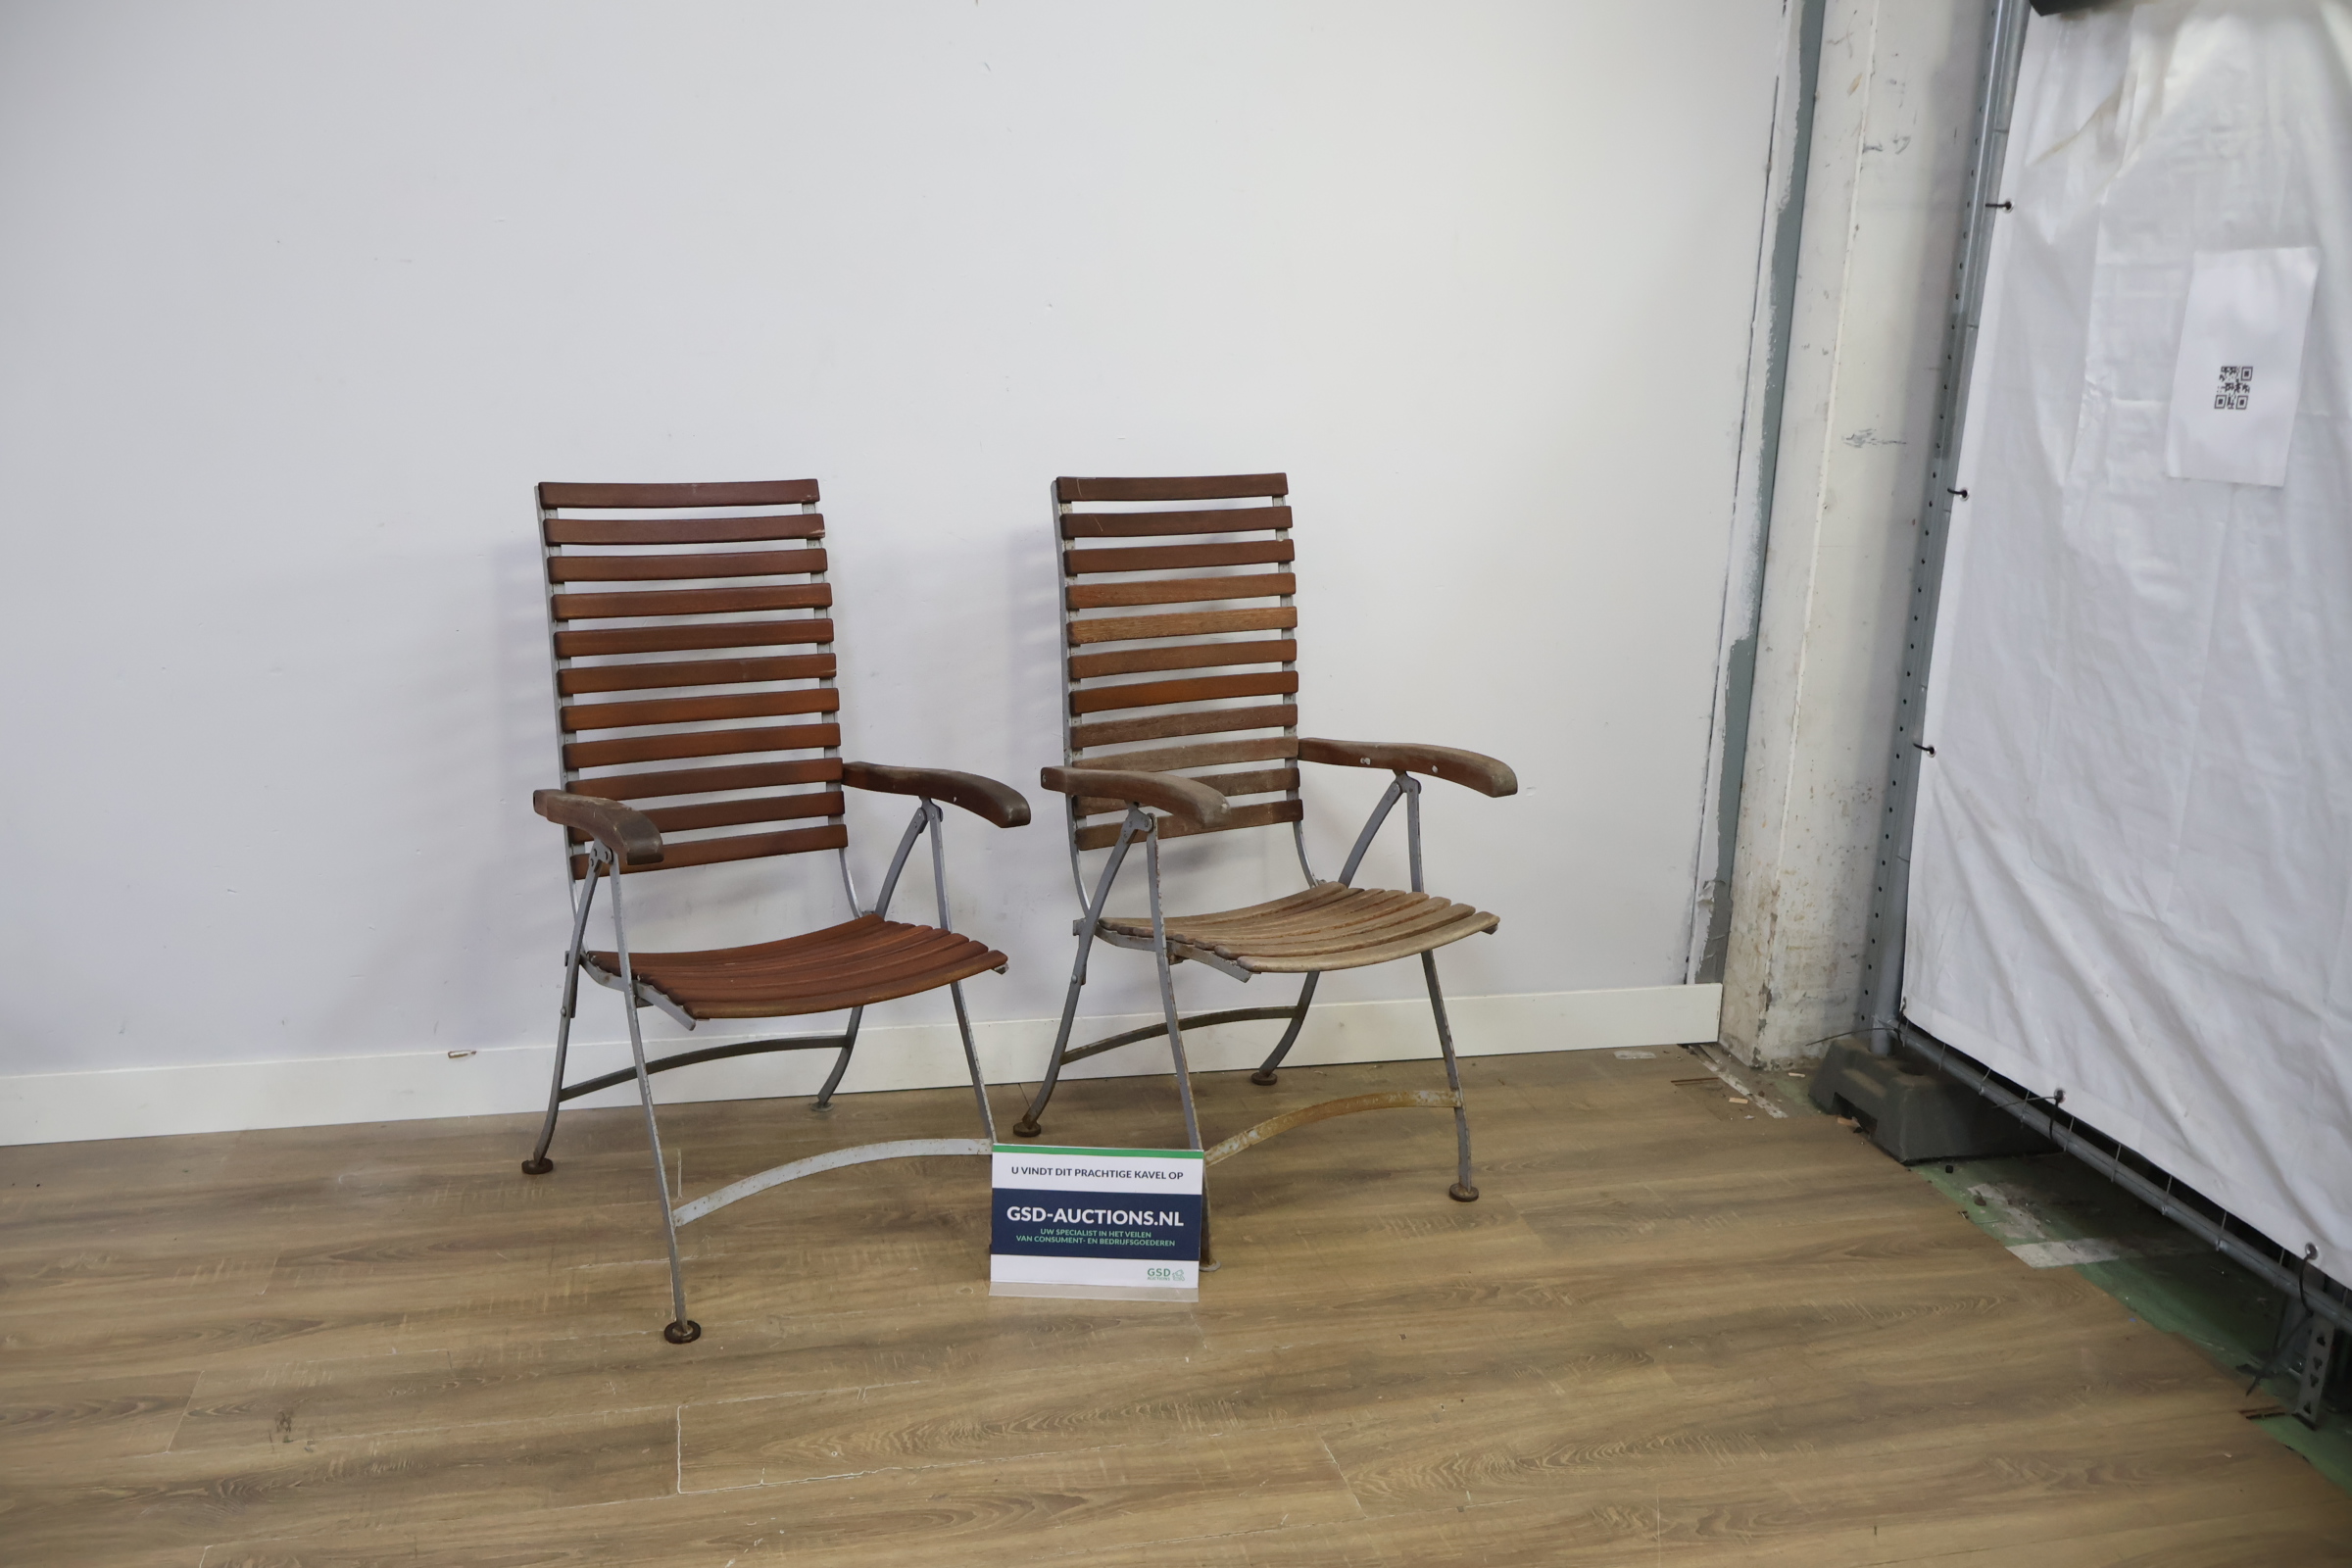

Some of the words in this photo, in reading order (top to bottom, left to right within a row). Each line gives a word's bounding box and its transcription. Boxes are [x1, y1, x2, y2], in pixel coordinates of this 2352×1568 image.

[1010, 1166, 1019, 1175] U
[1020, 1166, 1054, 1176] VINDT
[1054, 1167, 1073, 1177] DIT
[1074, 1168, 1132, 1179] PRACHTIGE
[1134, 1170, 1167, 1180] KAVEL
[1168, 1171, 1184, 1180] OP
[1006, 1205, 1185, 1227] GSD-AUCTIONS.NL
[1055, 1228, 1098, 1237] SPECIALIST
[1034, 1236, 1086, 1245] CONSUMENT-
[1099, 1238, 1176, 1247] BEDRIJFSGOEDEREN
[1147, 1267, 1171, 1277] GSD
